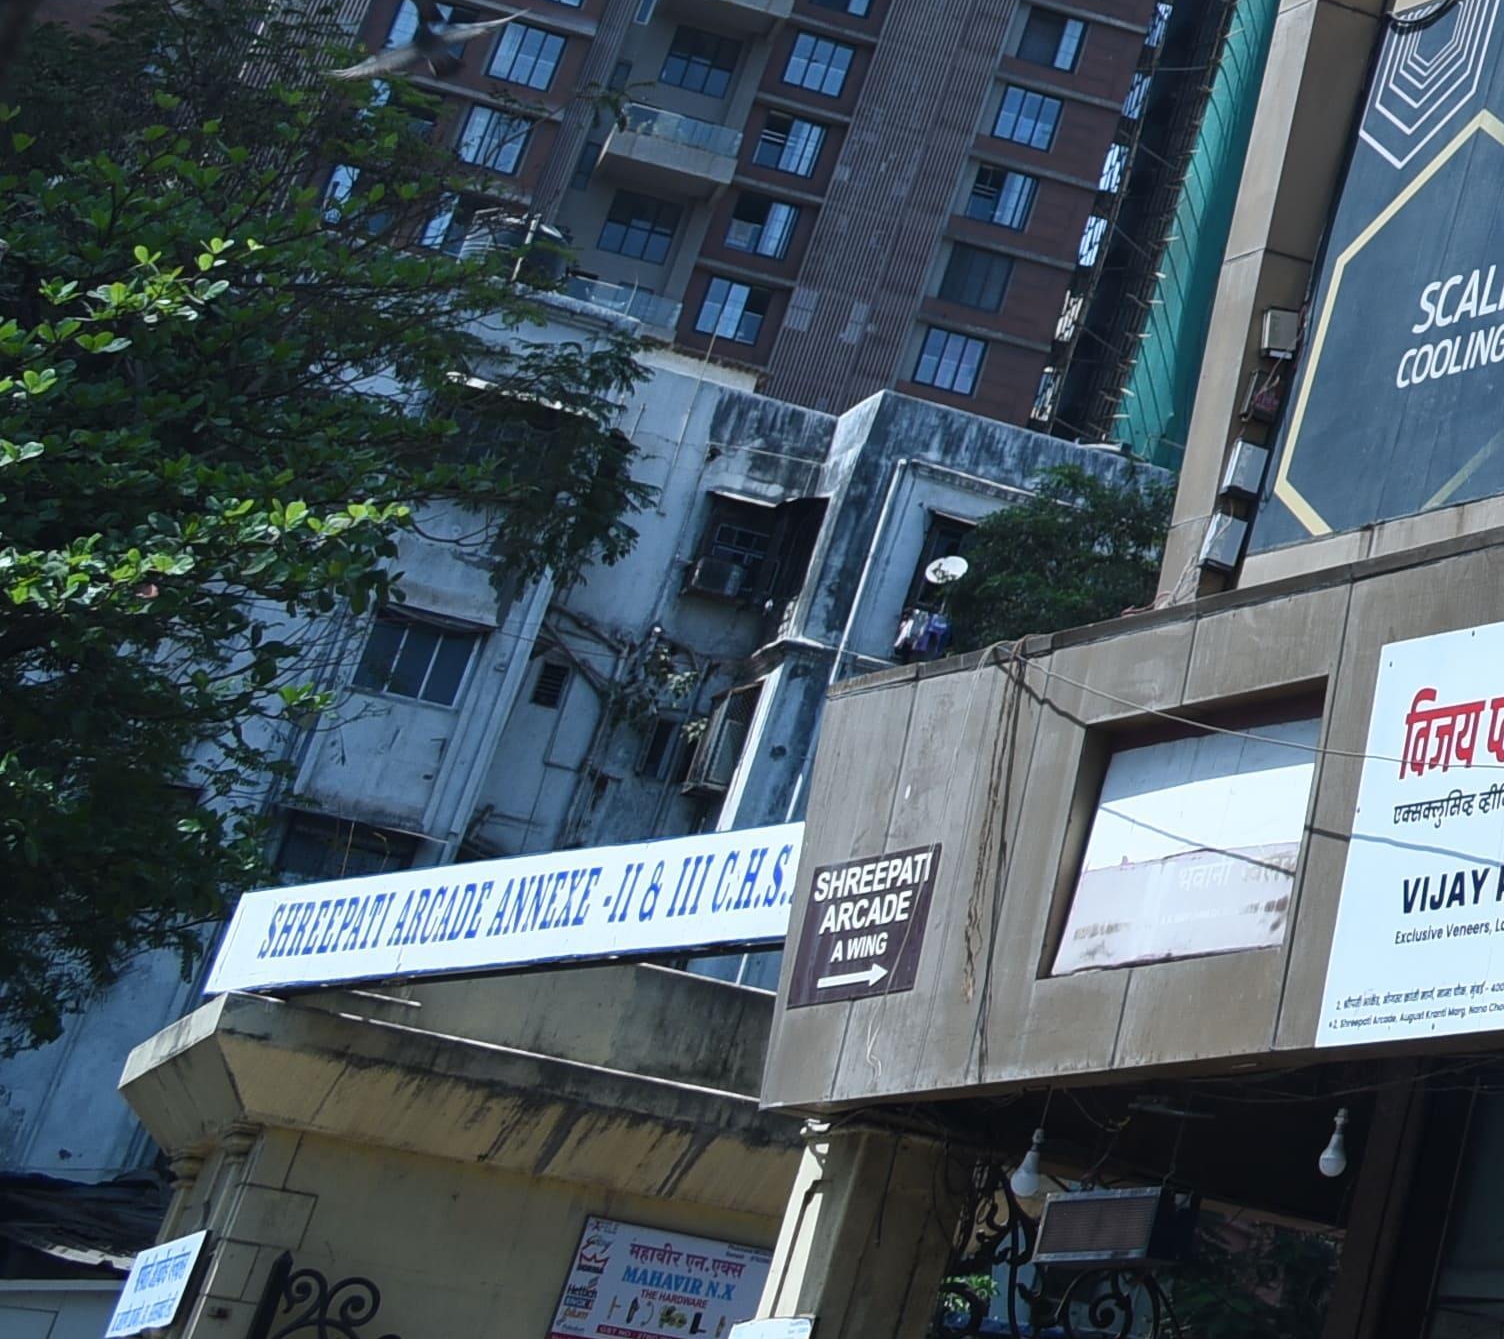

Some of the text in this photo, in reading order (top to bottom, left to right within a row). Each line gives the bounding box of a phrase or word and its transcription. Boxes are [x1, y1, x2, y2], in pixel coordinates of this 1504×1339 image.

[1399, 687, 1486, 780] विजय
[814, 852, 933, 902] SHREEPATI
[1402, 867, 1490, 914] VIJAY
[257, 892, 397, 960] SHREEPATI
[387, 880, 495, 947] ARCADE
[486, 867, 603, 936] ANNEXE
[639, 860, 665, 923] &
[666, 854, 715, 918] III
[818, 890, 913, 935] ARCADE
[830, 932, 889, 962] A WING
[1395, 924, 1444, 945] Exclusive
[1445, 919, 1492, 939] Veneers,
[622, 1266, 703, 1295] MAHAVIR
[640, 1289, 709, 1309] THE HARDWARE
